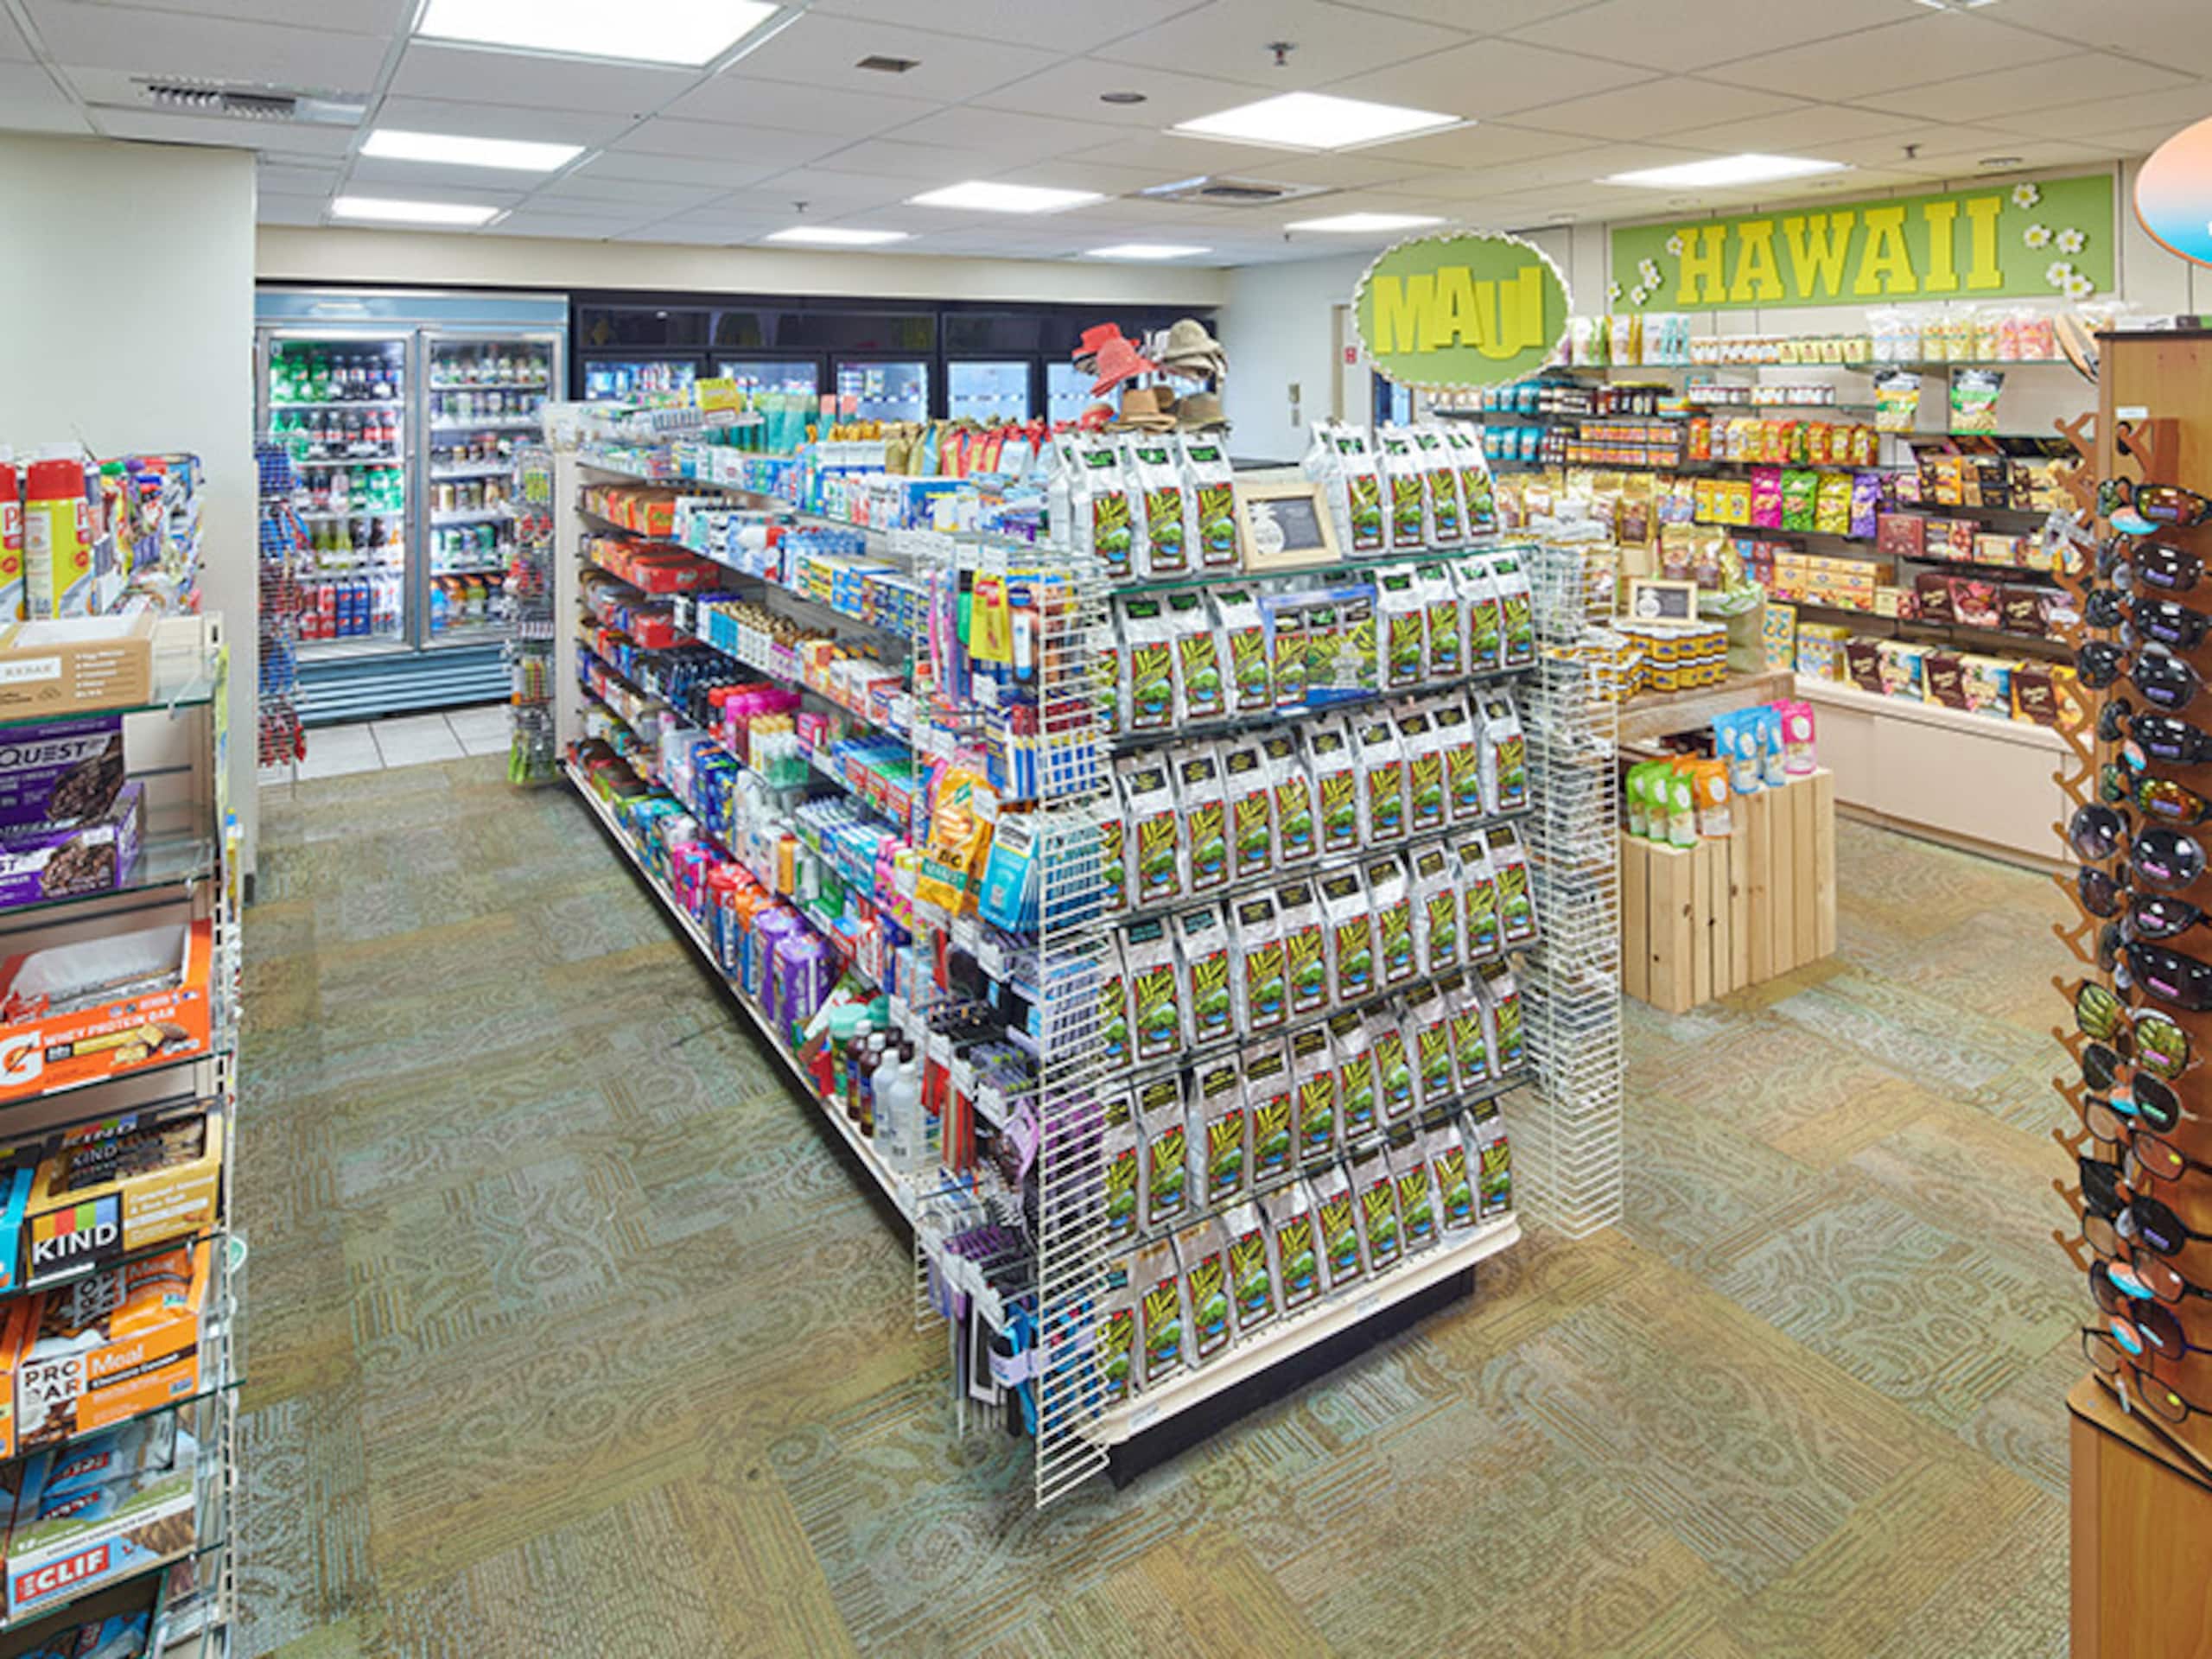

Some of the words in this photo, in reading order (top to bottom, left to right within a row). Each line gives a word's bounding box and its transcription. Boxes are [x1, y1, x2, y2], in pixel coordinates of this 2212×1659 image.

[1675, 195, 2003, 305] HAWAII
[1373, 265, 1544, 359] MAUI
[0, 741, 86, 768] QUEST
[32, 1221, 118, 1265] KIND
[25, 1360, 82, 1388] PRO
[26, 1378, 82, 1402] AR
[37, 1548, 105, 1590] CLIF
